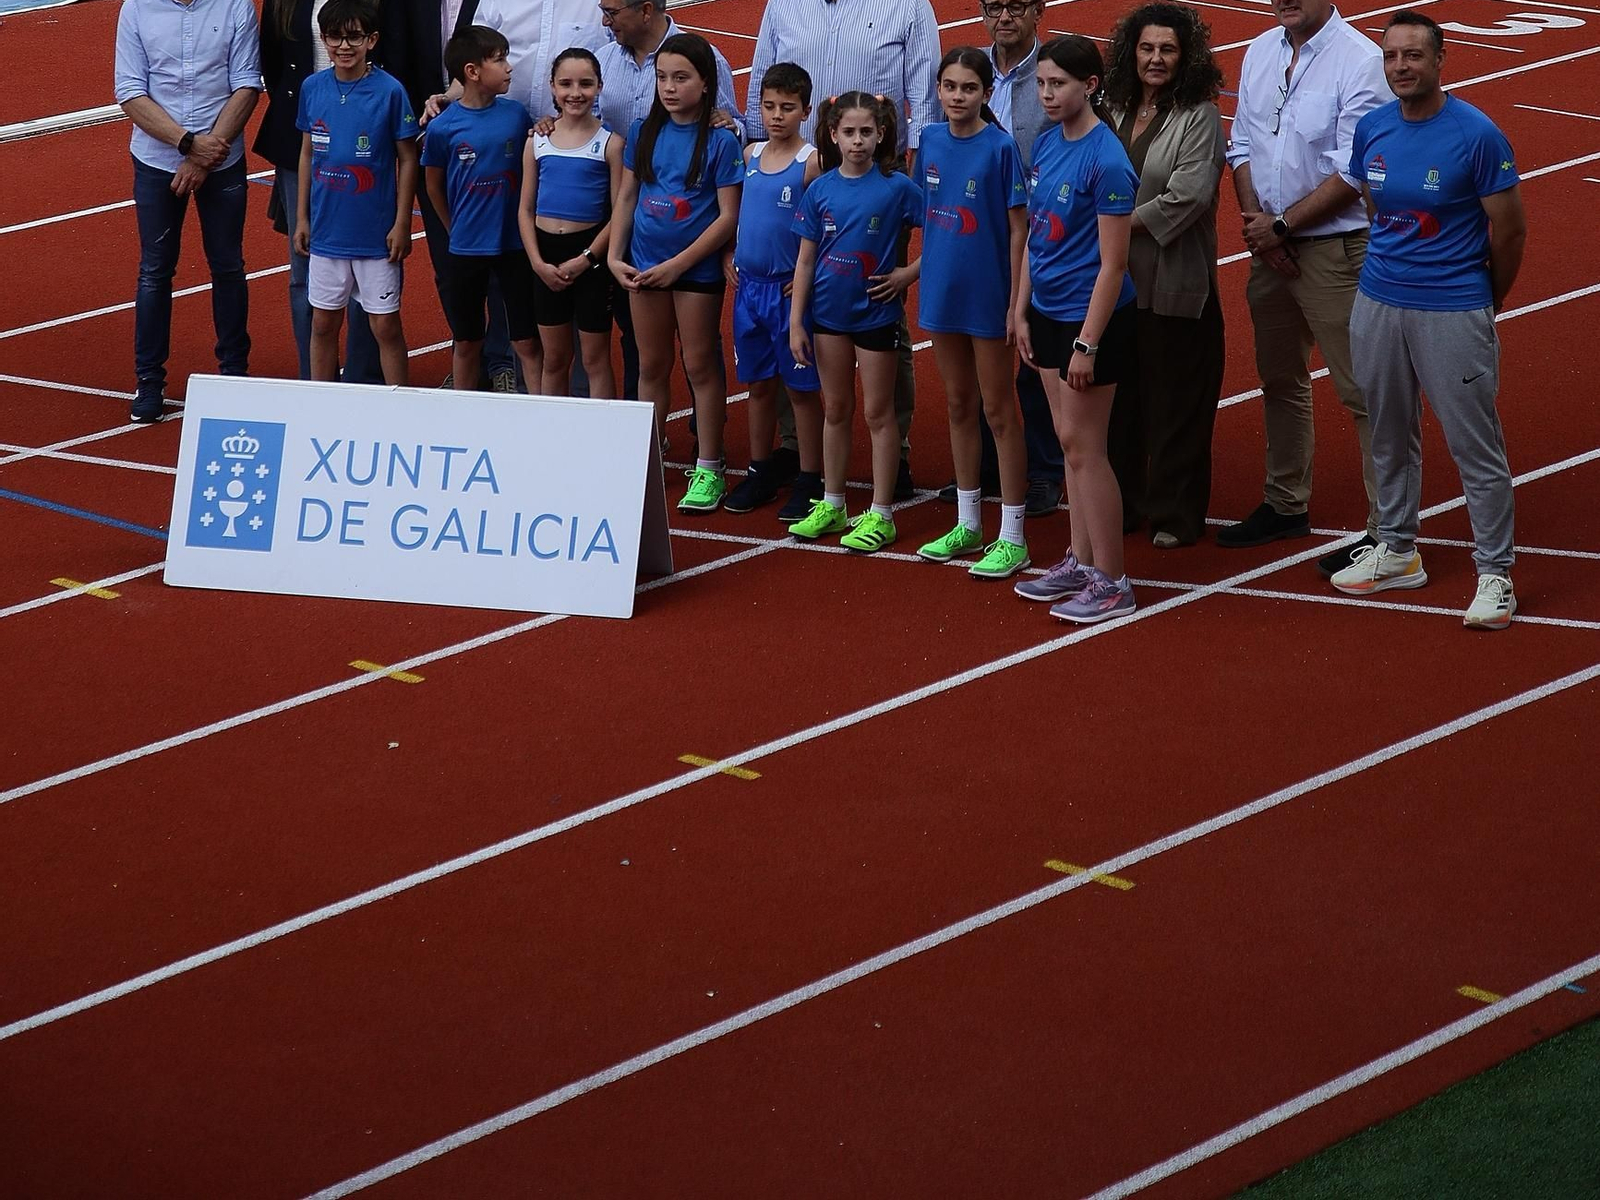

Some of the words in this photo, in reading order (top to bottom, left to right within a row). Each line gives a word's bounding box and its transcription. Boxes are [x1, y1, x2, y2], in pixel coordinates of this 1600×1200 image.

[1438, 12, 1587, 36] 3
[304, 437, 500, 494] XUNTA
[296, 498, 369, 546] DE
[390, 503, 620, 564] GALICIA
